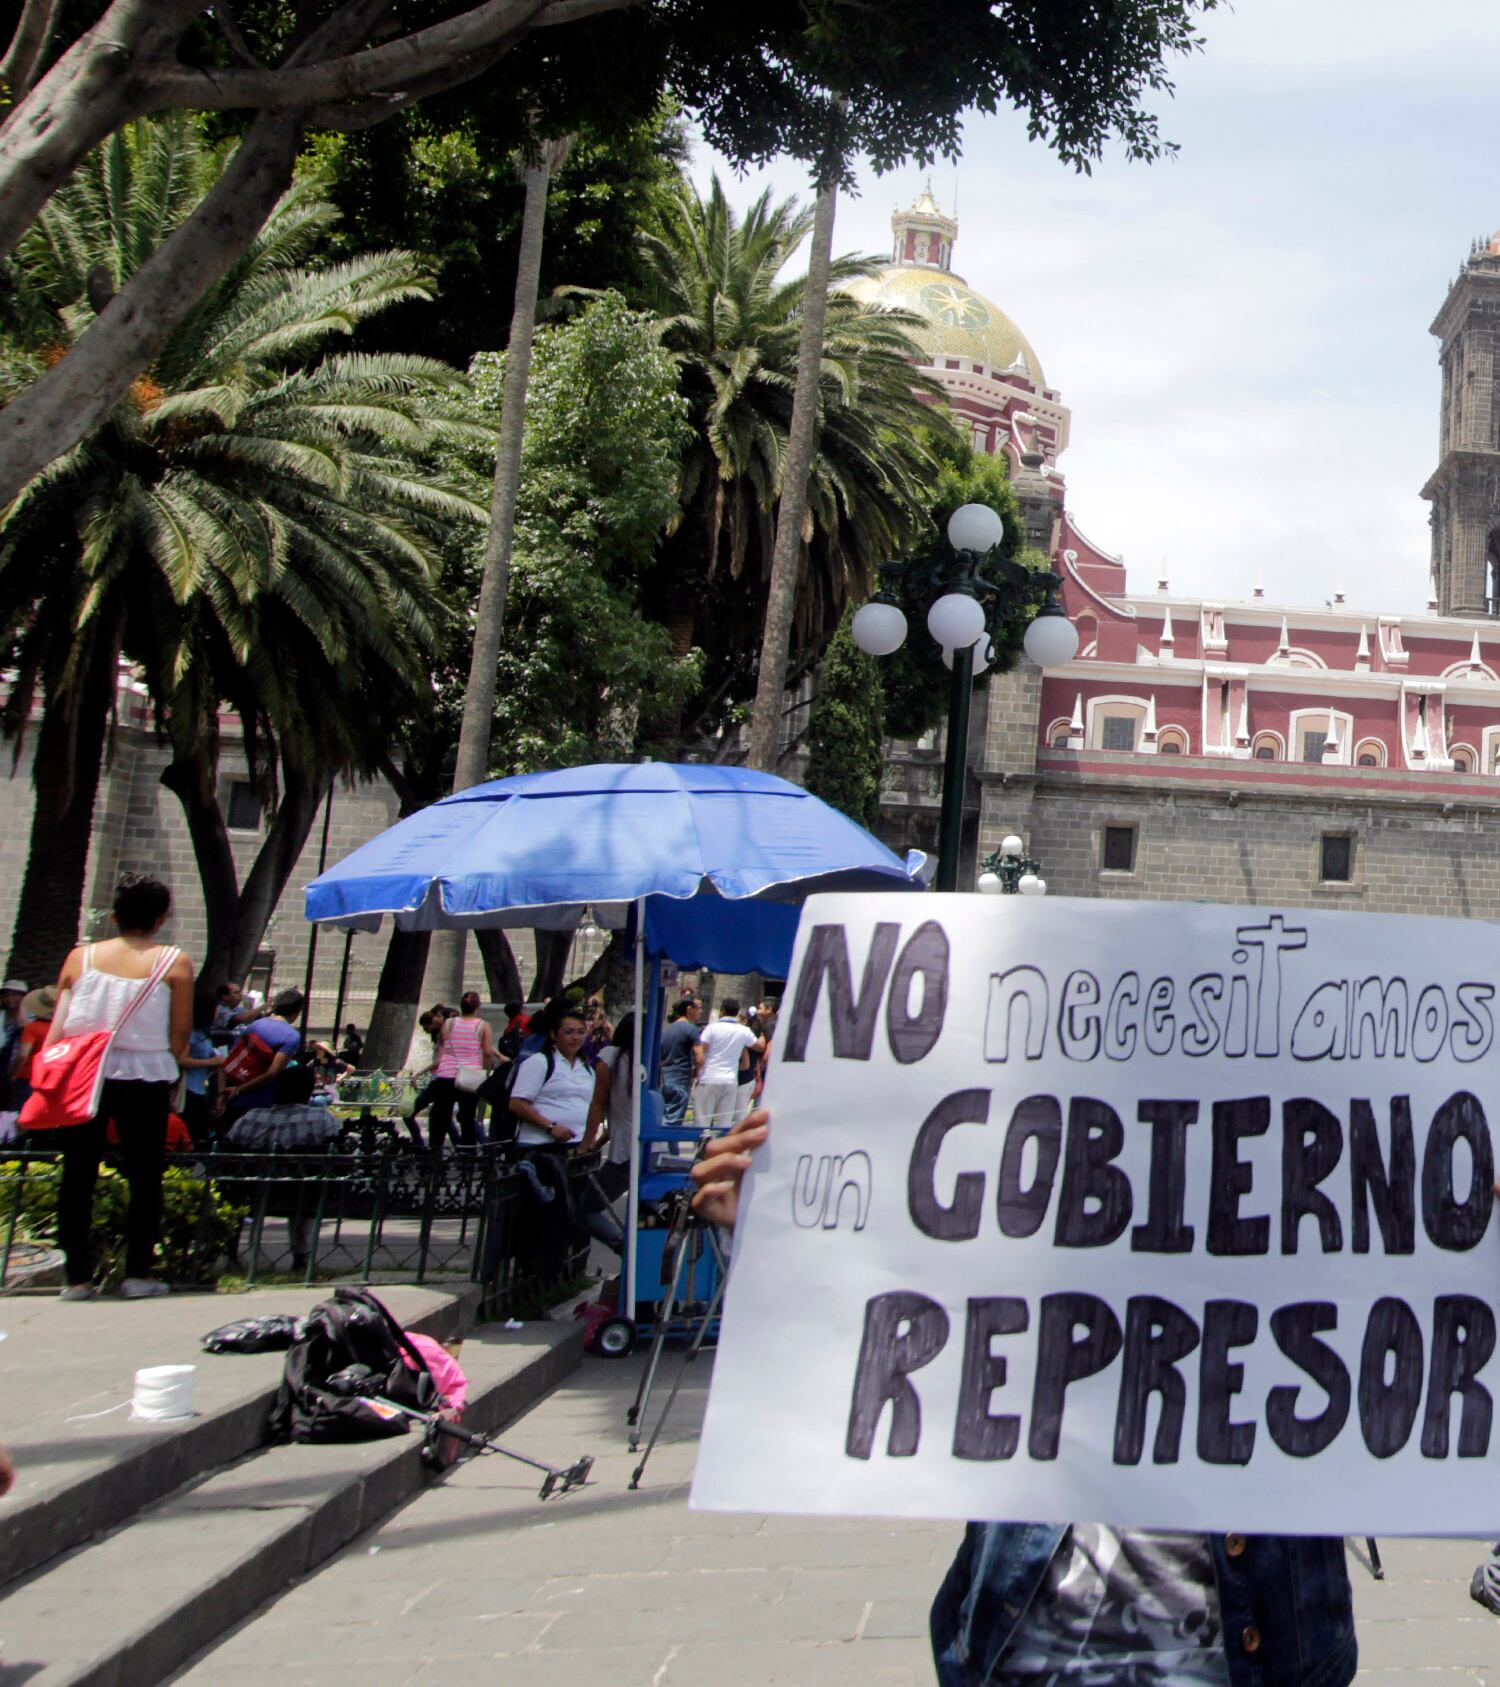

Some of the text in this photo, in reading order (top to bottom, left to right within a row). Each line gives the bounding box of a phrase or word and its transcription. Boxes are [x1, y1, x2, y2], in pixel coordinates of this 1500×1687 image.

[782, 915, 1496, 1065] NO necesitamos
[791, 1088, 1496, 1256] un GOBIERNO
[845, 1290, 1498, 1466] REPRESOR
